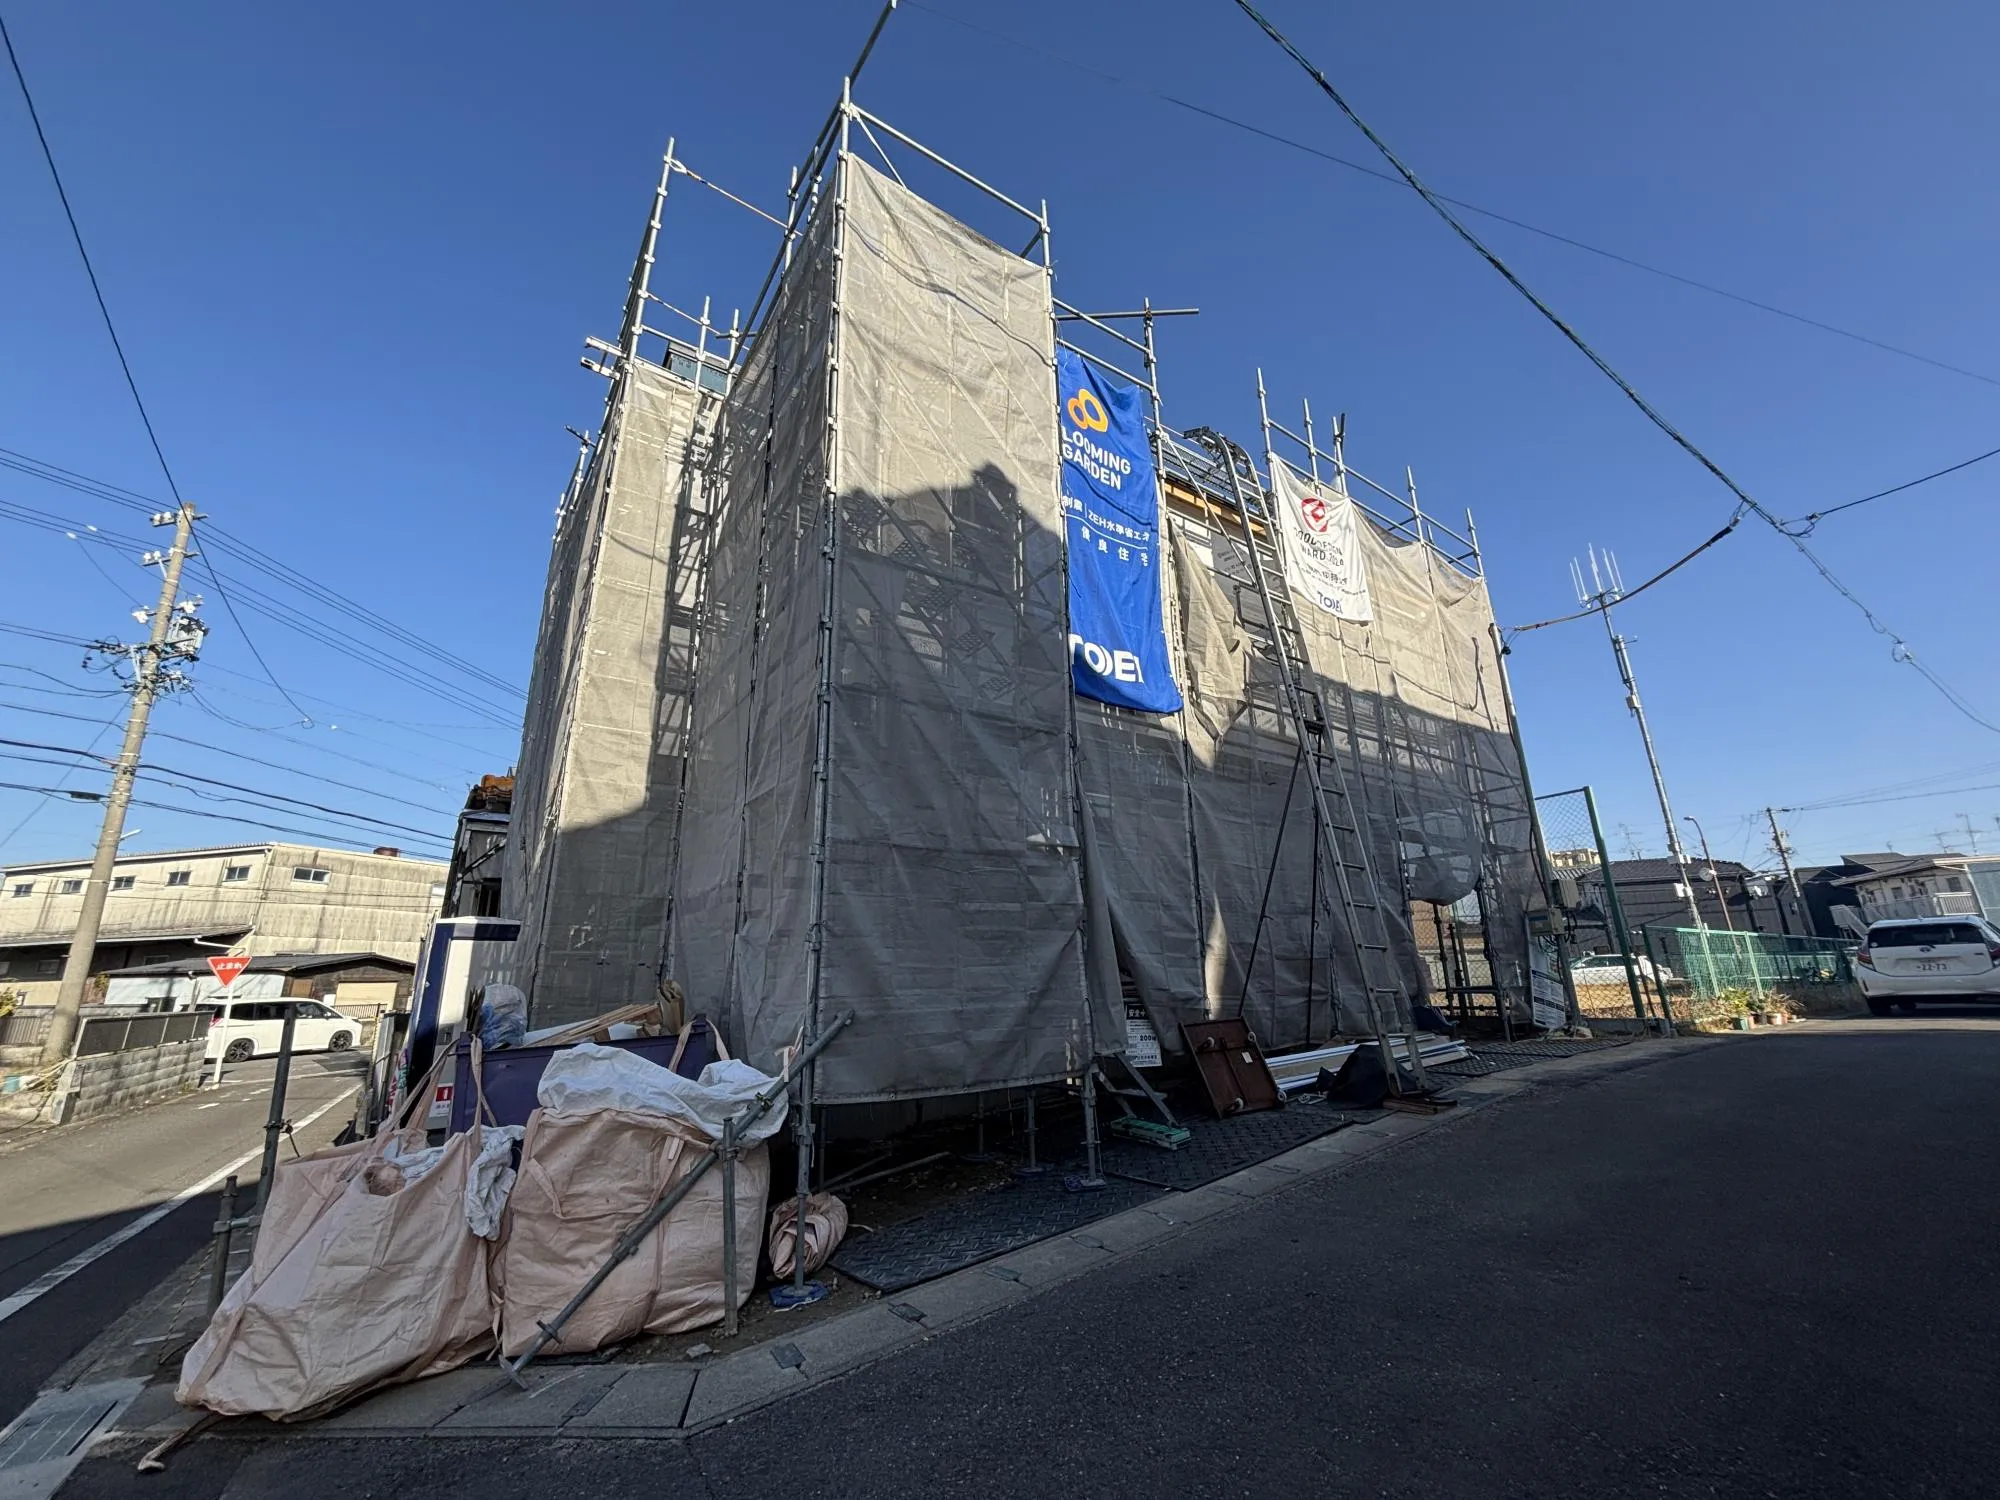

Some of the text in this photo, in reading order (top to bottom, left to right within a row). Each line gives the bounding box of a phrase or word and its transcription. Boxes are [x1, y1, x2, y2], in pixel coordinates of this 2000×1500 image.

[1061, 425, 1131, 475] LOOMING
[1062, 443, 1121, 491] GARDEN
[1068, 633, 1145, 684] TOEI
